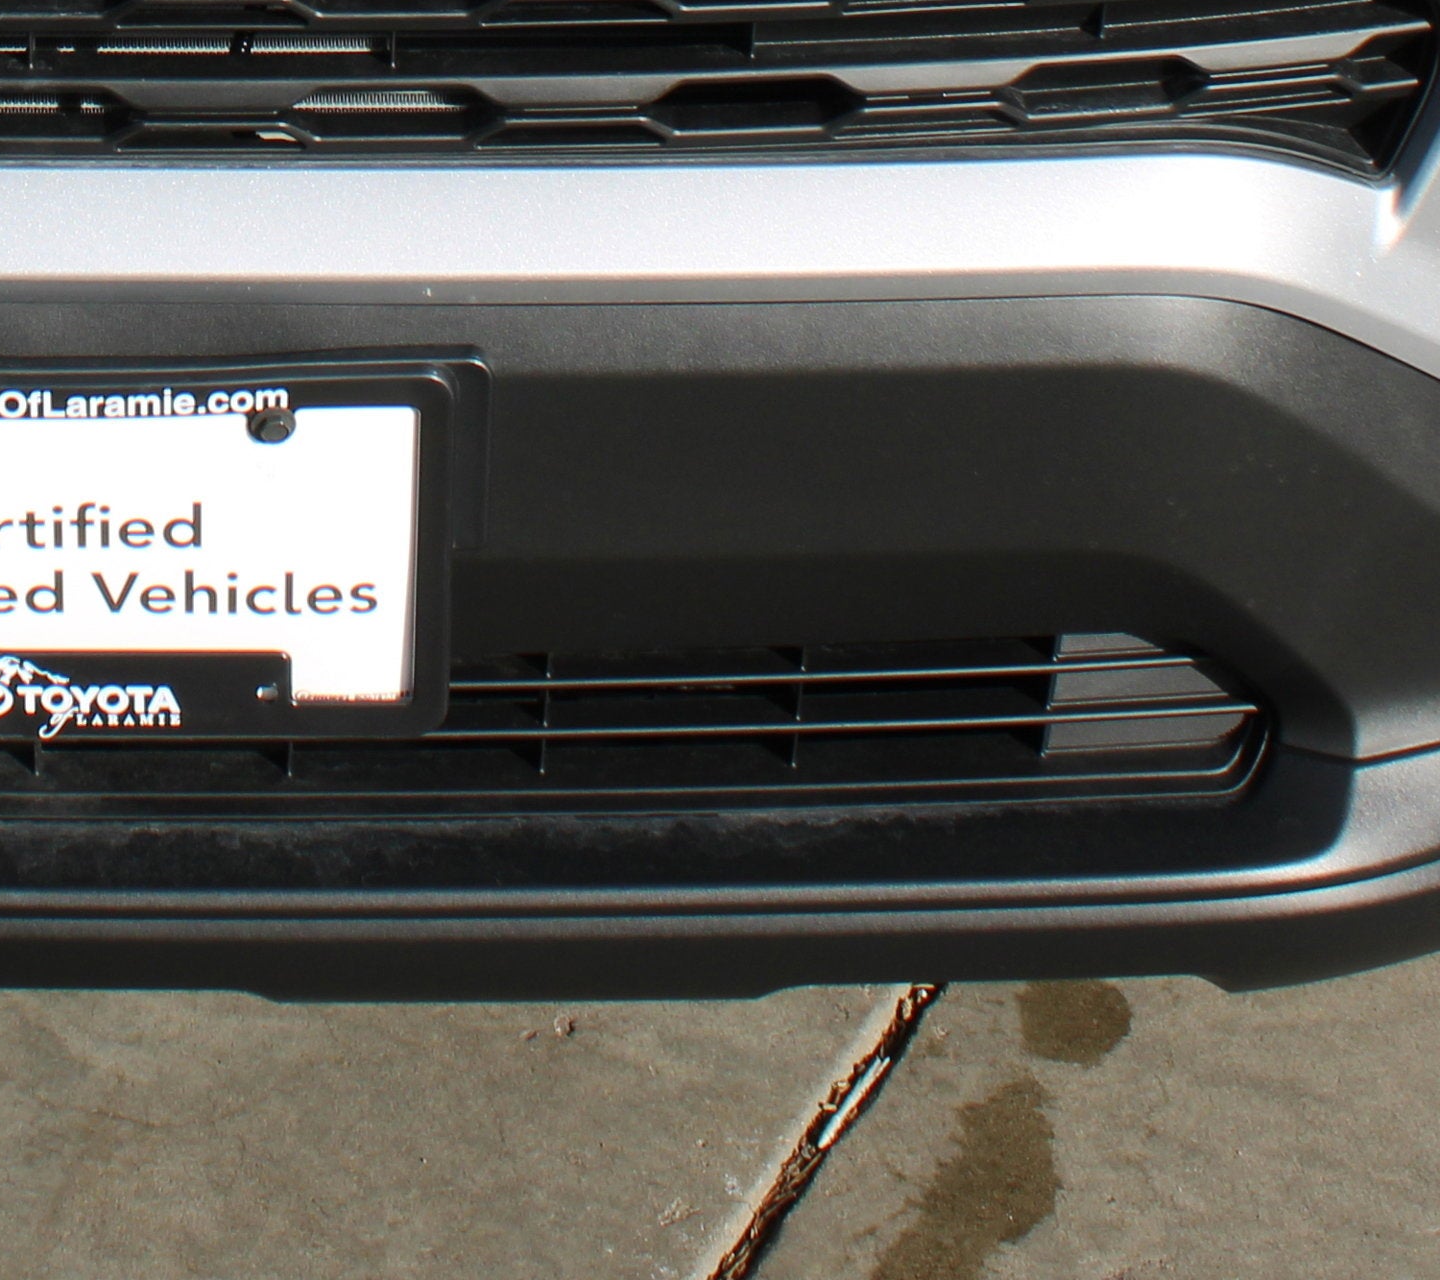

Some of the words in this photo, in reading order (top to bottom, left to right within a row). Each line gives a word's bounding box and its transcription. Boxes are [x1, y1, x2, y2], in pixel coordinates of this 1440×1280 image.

[90, 569, 378, 616] Vehicles
[17, 683, 182, 715] TOYOTA
[76, 713, 182, 727] LARAMIE
